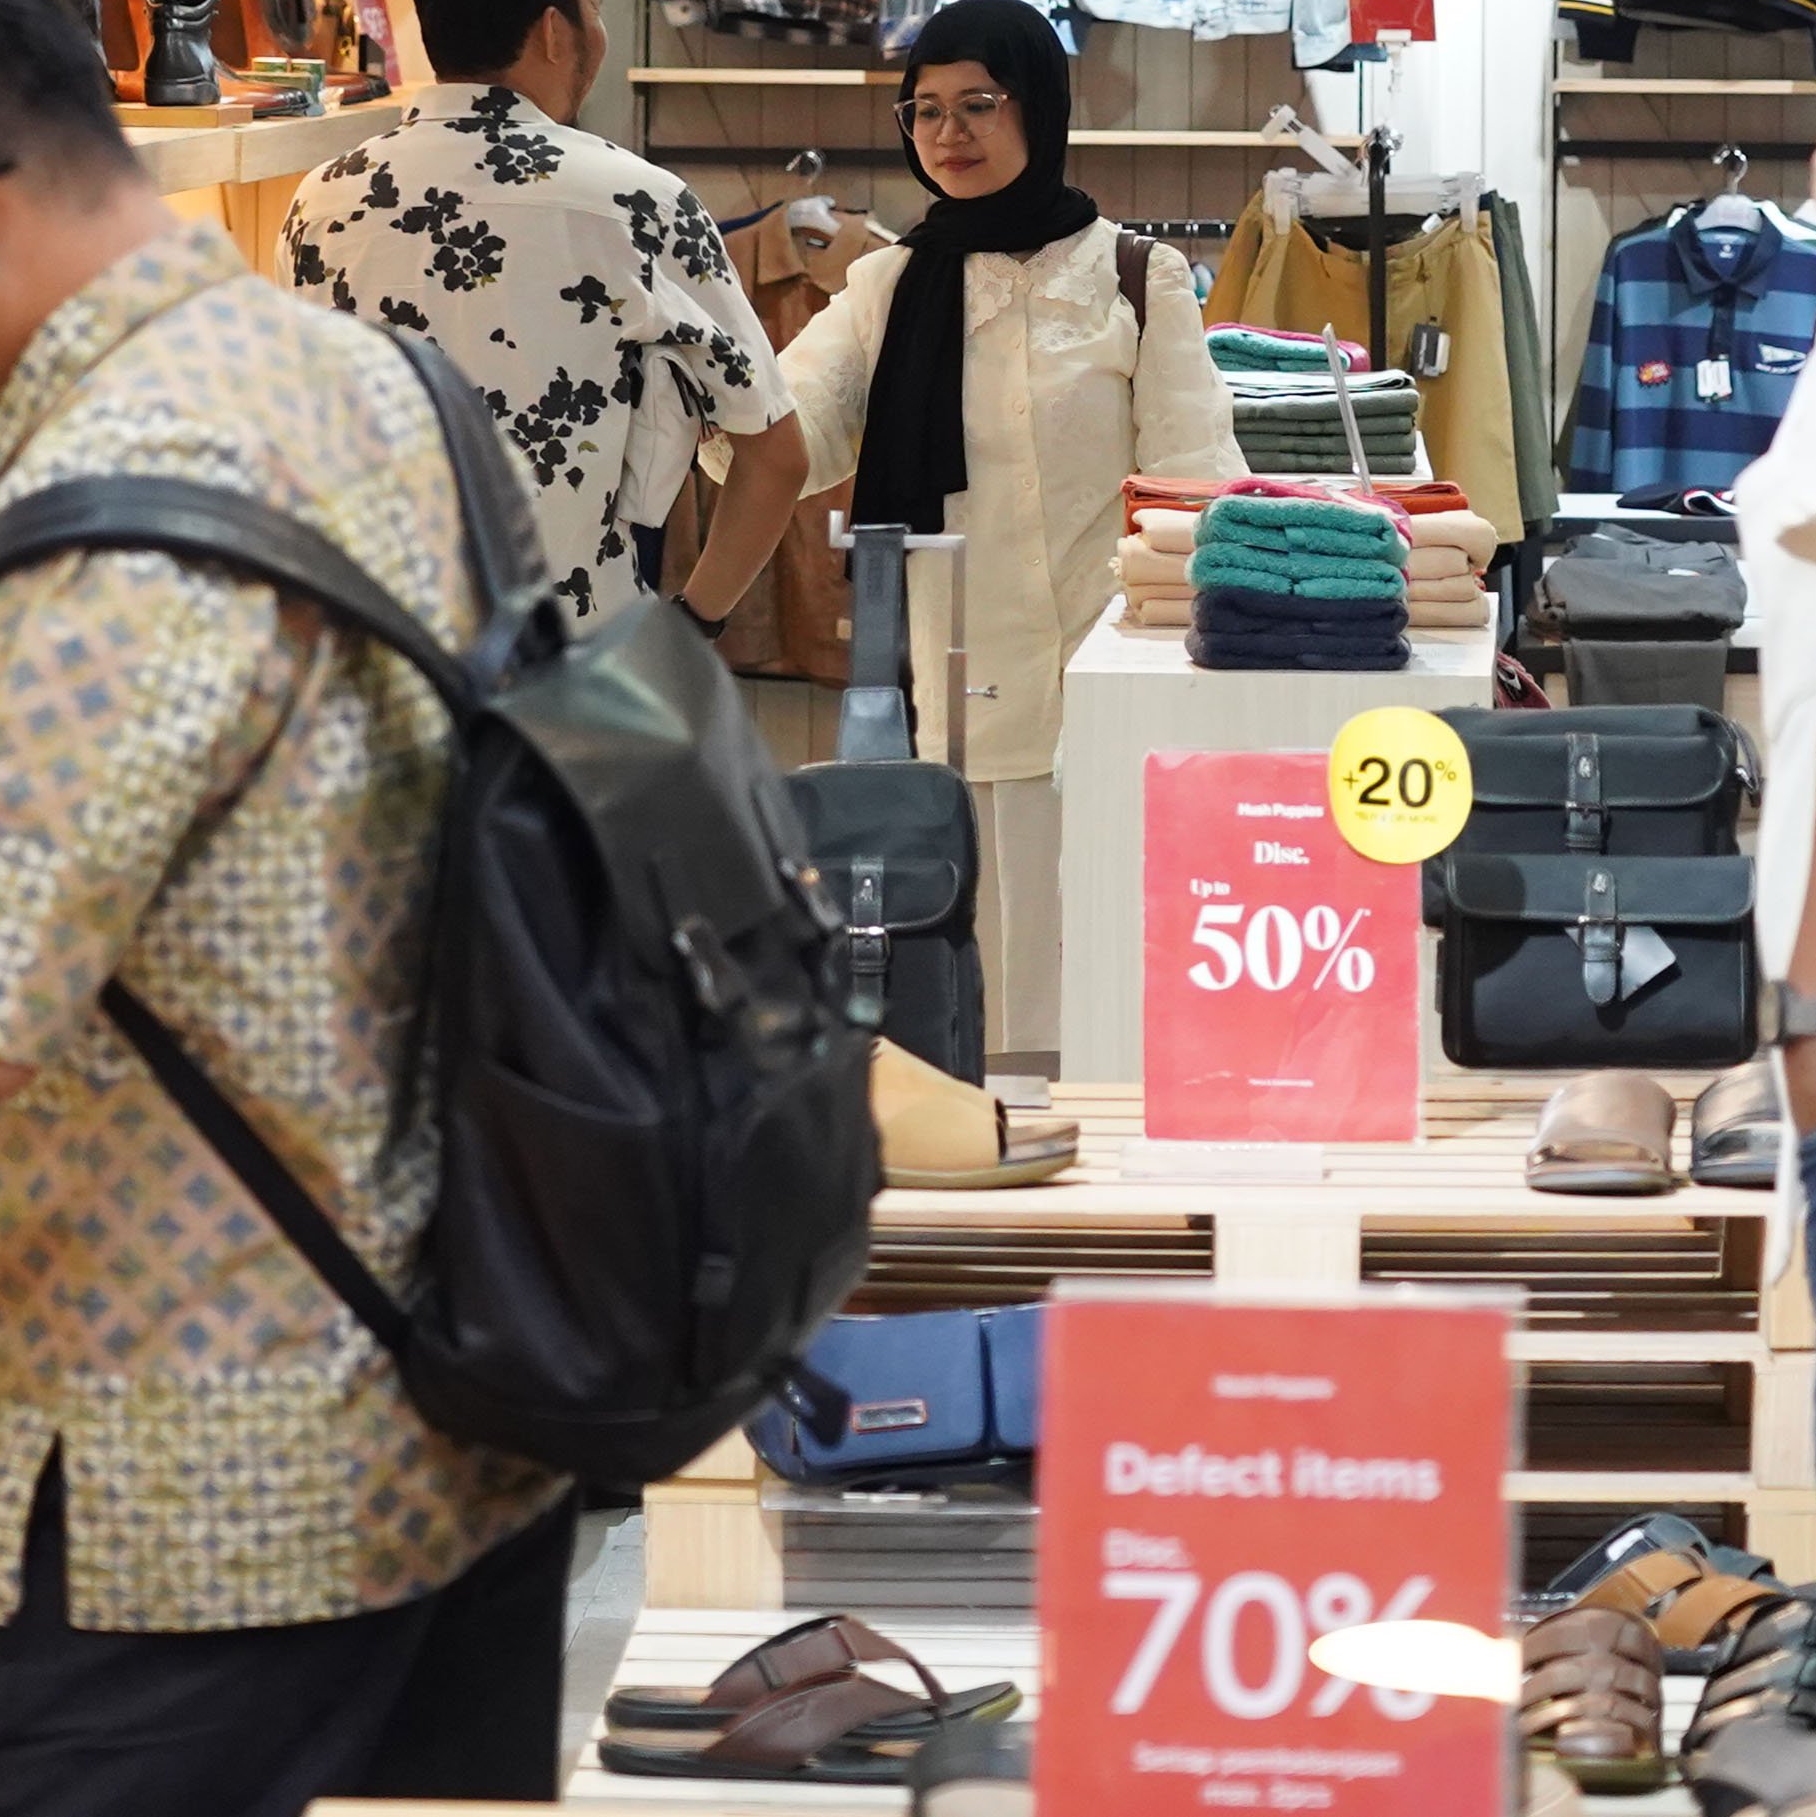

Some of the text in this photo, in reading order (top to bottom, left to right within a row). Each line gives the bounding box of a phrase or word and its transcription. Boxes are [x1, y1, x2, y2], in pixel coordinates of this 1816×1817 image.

[1343, 756, 1457, 808] +20%
[1253, 841, 1311, 865] Disc.
[1188, 904, 1375, 993] 50%
[1104, 1441, 1442, 1502] Defect items
[1101, 1569, 1438, 1722] 70%
